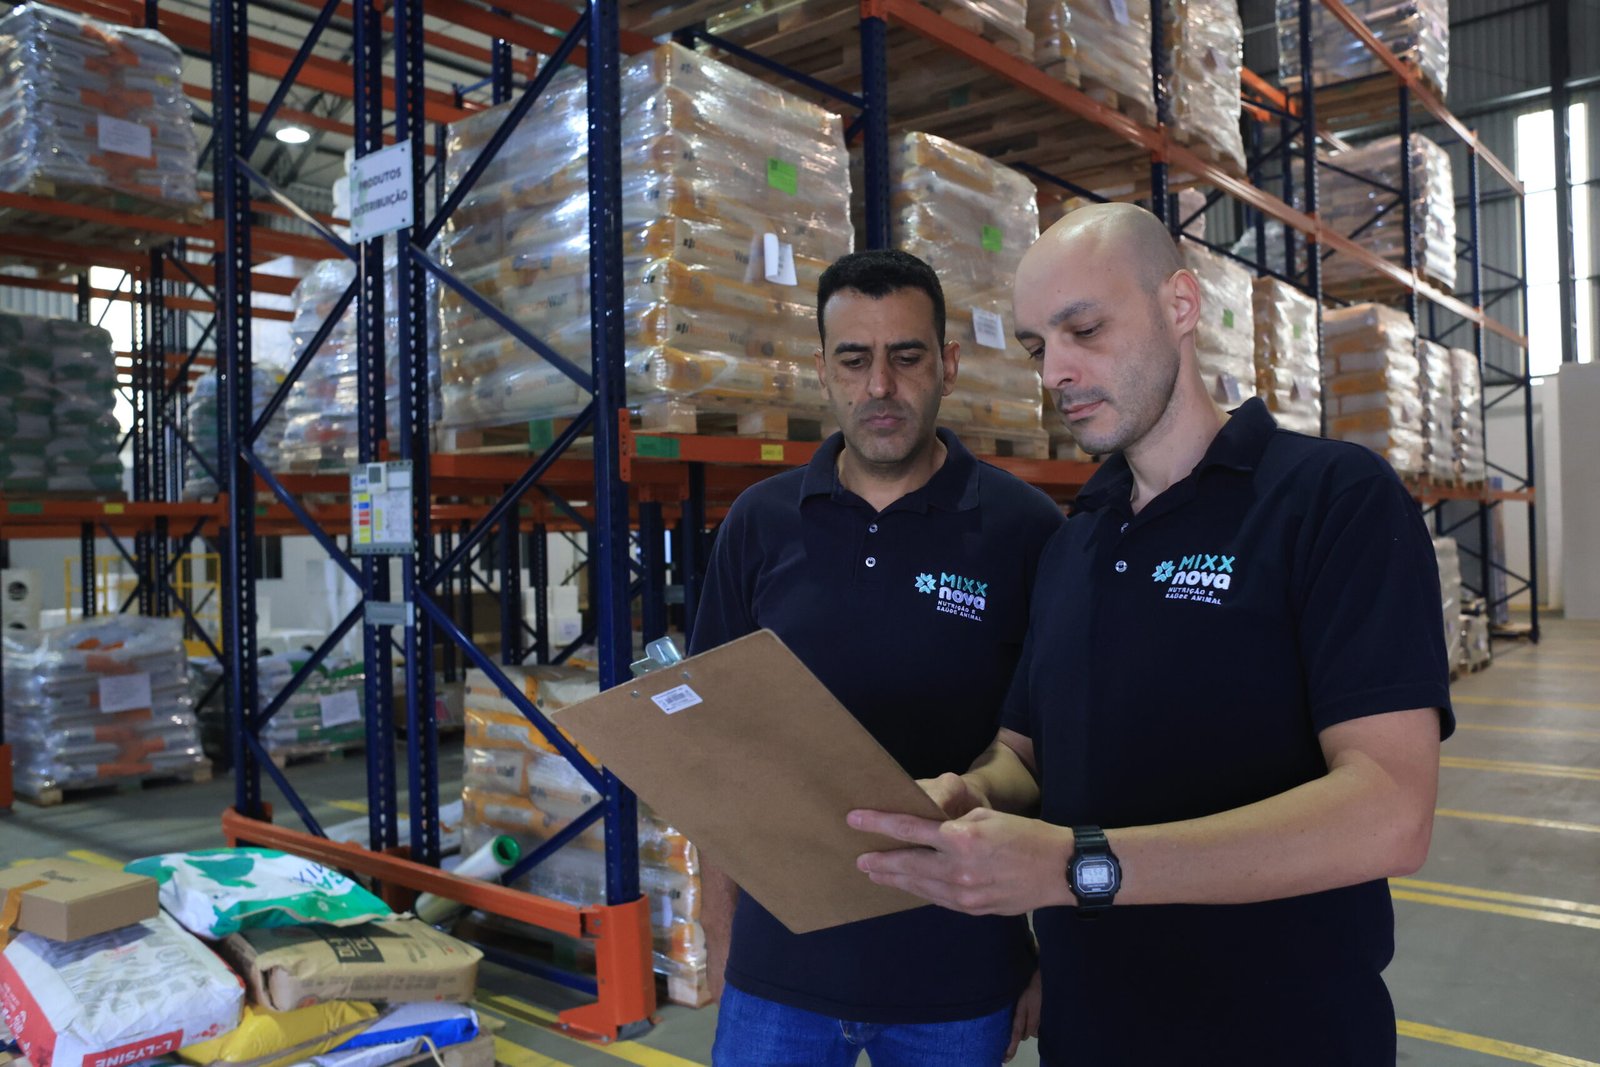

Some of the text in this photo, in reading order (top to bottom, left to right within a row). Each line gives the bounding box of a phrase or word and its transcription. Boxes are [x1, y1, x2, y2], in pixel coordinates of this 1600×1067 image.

[1178, 553, 1235, 573] MIXX
[940, 572, 988, 597] MIXX
[1171, 570, 1231, 590] nova
[938, 586, 986, 610] nova
[1191, 595, 1222, 605] ANIMAL
[959, 611, 982, 622] ANIMAL
[95, 1039, 173, 1067] L-LYSINE
